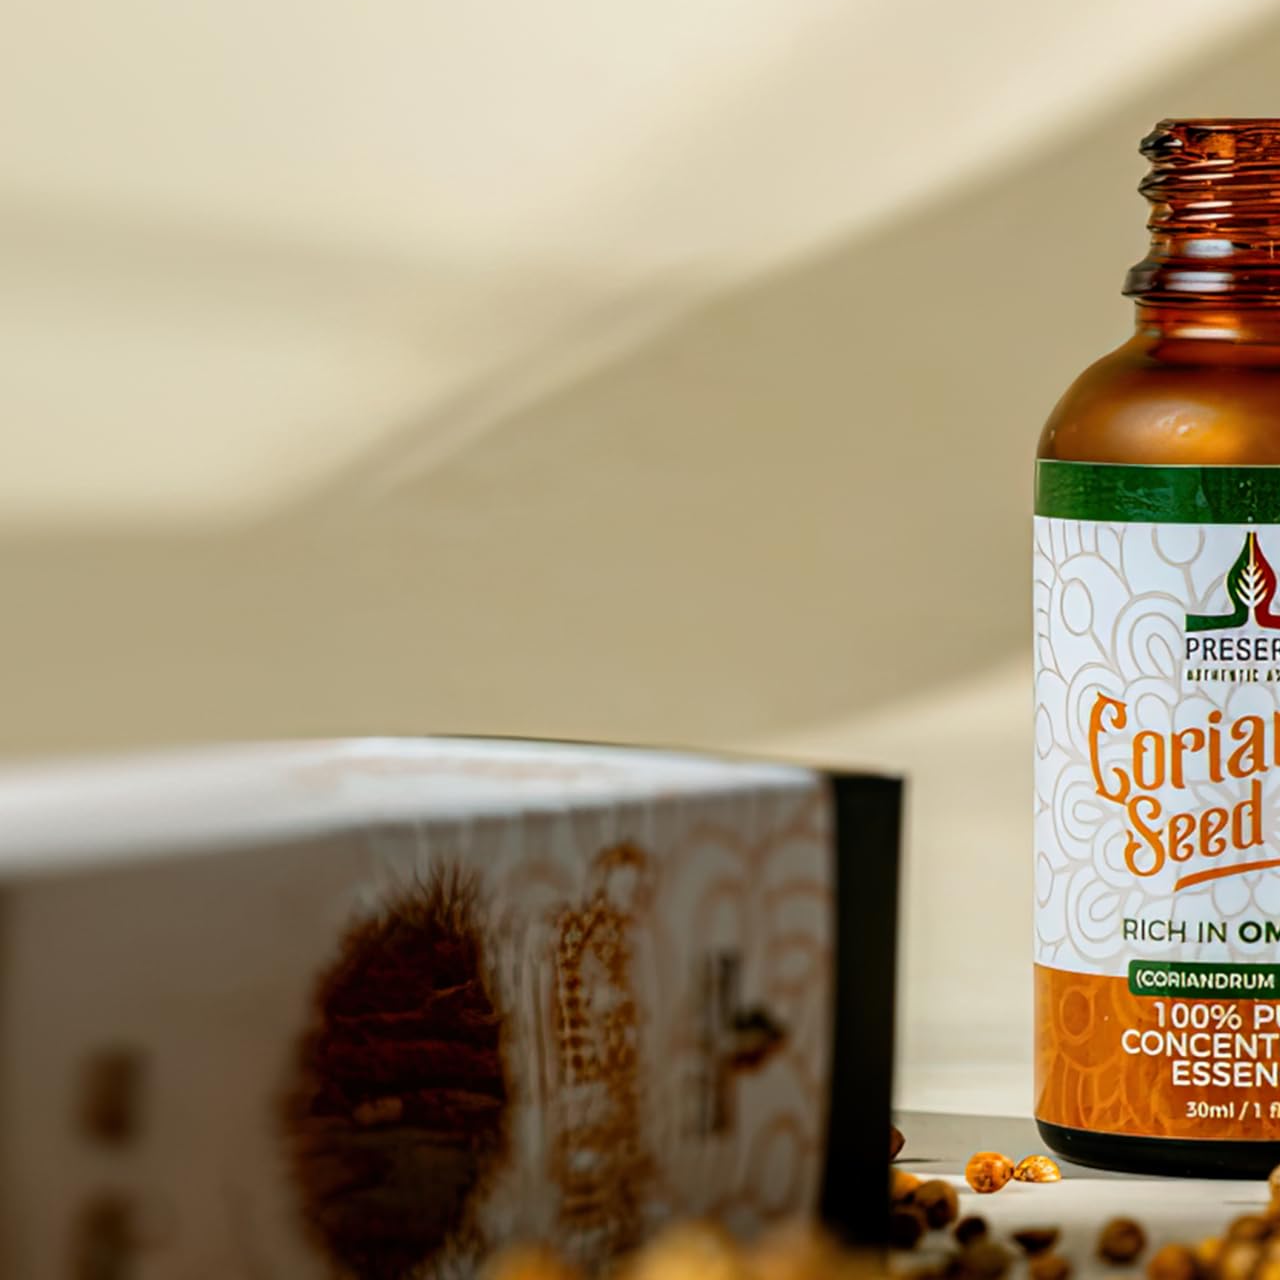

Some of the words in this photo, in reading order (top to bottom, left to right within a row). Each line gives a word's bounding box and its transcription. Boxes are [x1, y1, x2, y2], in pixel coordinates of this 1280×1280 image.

[1124, 779, 1265, 877] Seed
[1123, 918, 1186, 943] RICH
[1199, 921, 1227, 944] IN
[1136, 969, 1275, 989] (CORIANDRUM
[1153, 1001, 1242, 1030] 100%
[1186, 1101, 1235, 1118] 30ml
[1253, 1102, 1262, 1118] 1
